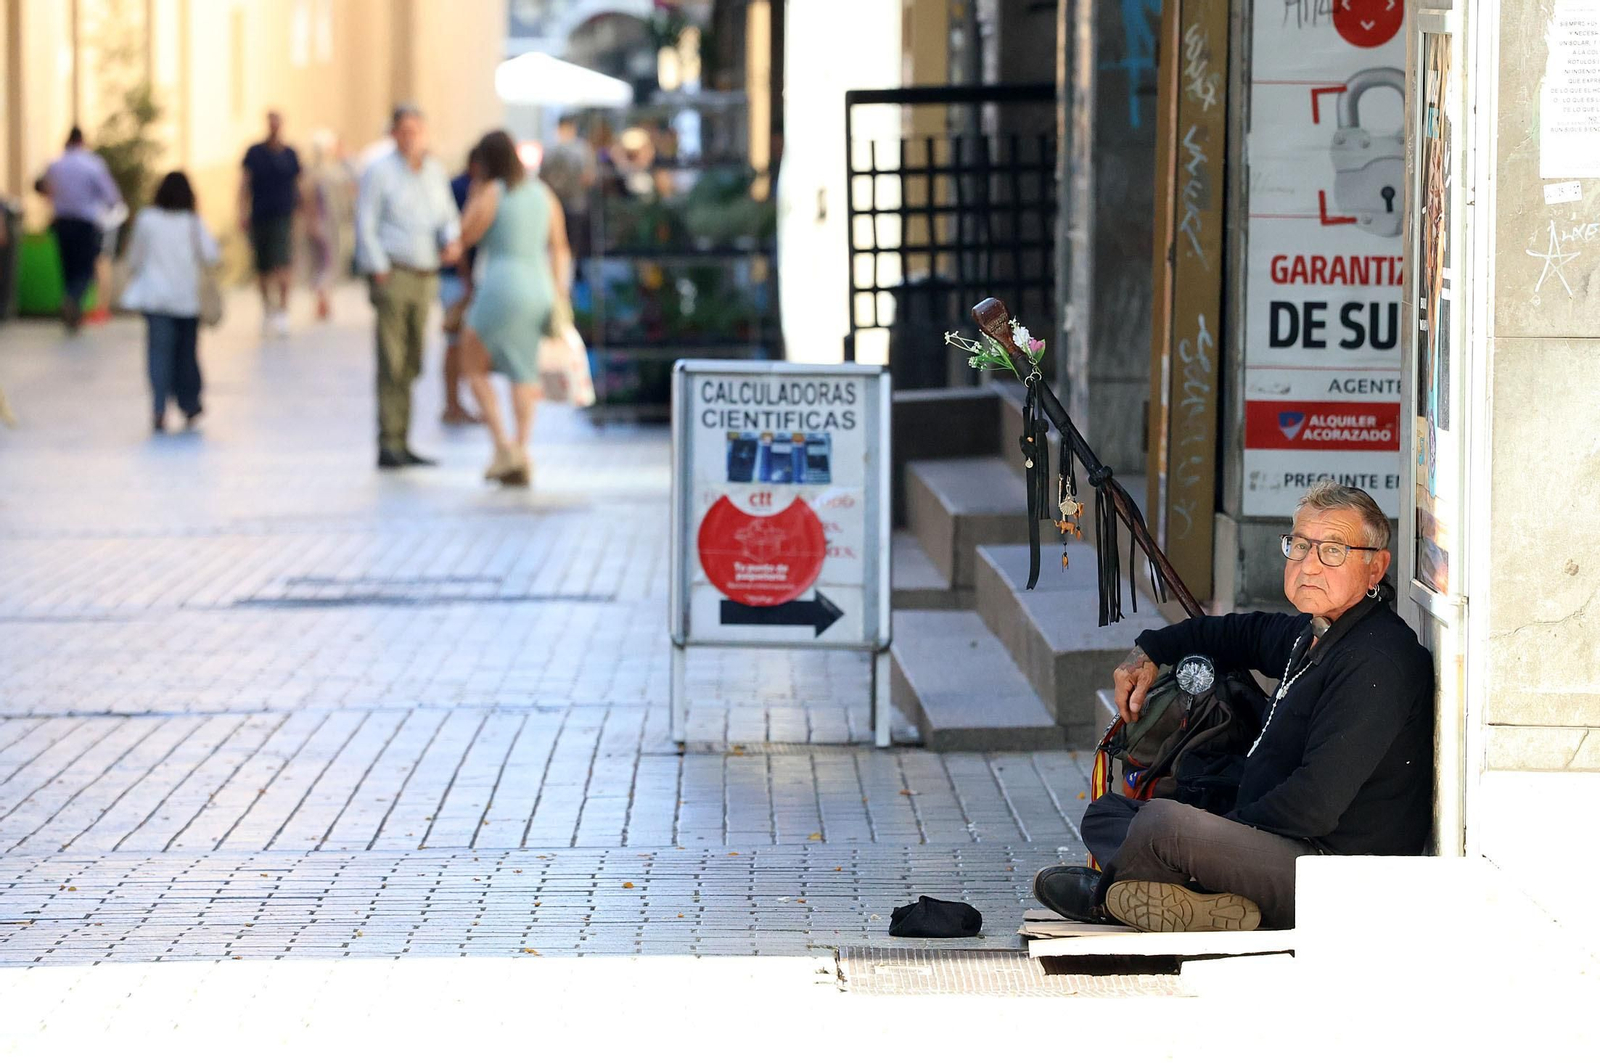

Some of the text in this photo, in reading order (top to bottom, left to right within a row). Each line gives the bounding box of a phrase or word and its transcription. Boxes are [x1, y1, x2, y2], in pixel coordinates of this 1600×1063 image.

[1269, 301, 1328, 349] DE
[1339, 301, 1398, 350] SU
[701, 380, 857, 406] CALCULADORAS
[701, 409, 857, 430] CIENTIFICAS
[1308, 414, 1377, 428] ALQUILER
[1302, 428, 1392, 442] ACORAZADO
